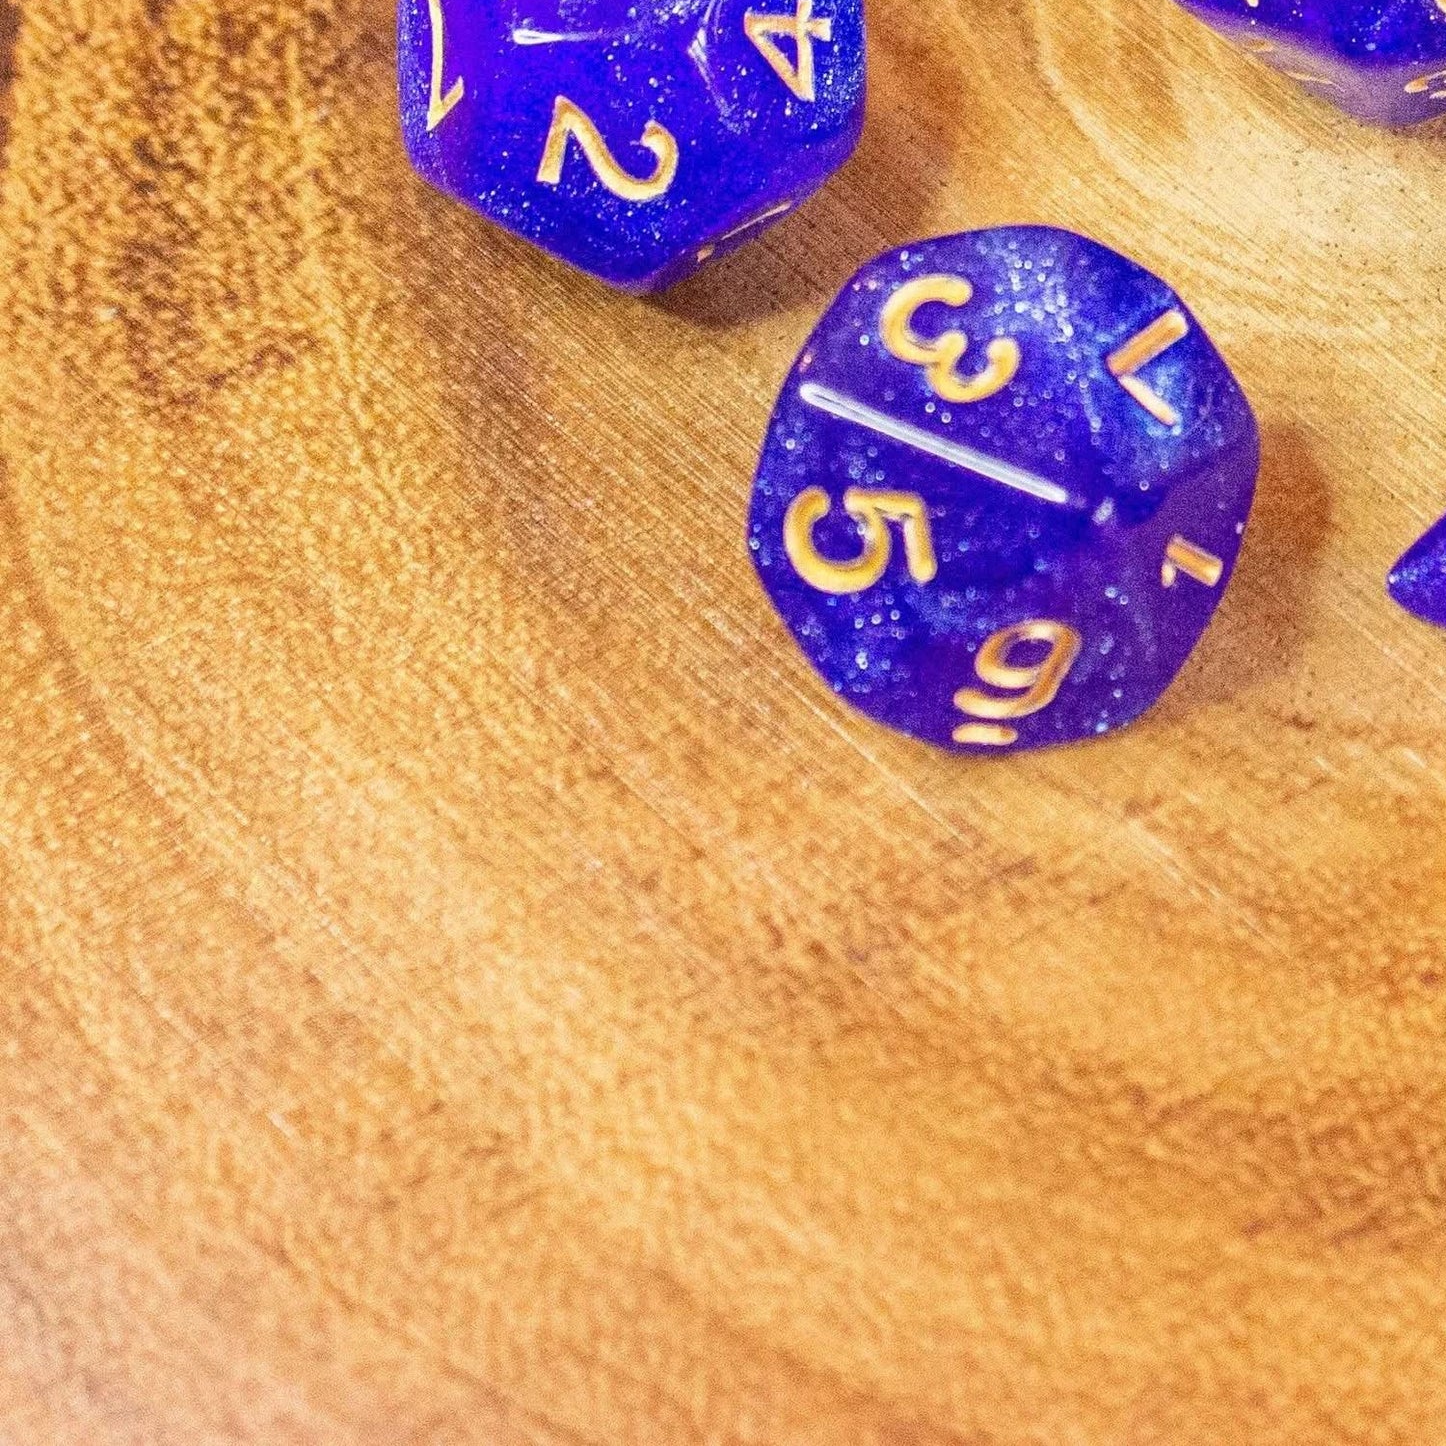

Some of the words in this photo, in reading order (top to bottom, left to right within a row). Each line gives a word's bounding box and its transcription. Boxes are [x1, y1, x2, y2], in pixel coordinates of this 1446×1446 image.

[535, 95, 680, 203] 2
[879, 273, 1020, 404] 3
[782, 485, 938, 596] 5
